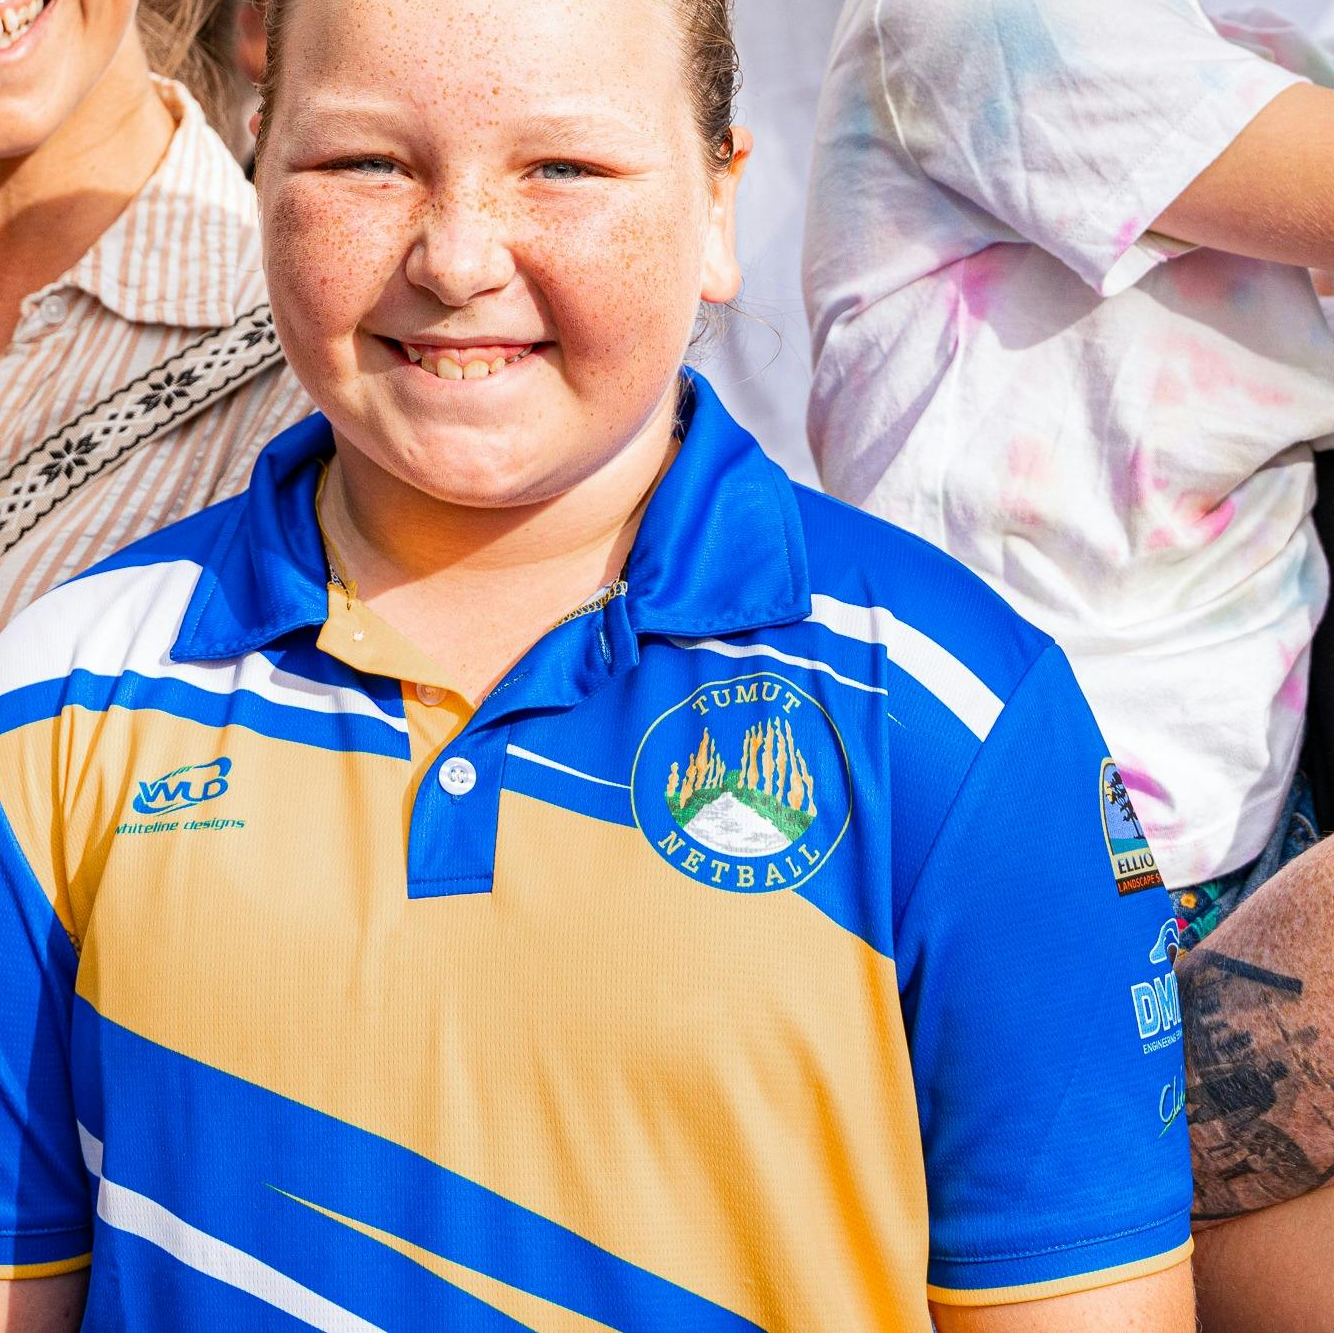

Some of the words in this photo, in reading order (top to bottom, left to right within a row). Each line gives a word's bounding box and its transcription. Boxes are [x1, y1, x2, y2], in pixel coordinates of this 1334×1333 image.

[691, 681, 802, 716] TUMUT
[183, 817, 245, 831] designs
[657, 830, 820, 888] NETBALL
[1117, 852, 1155, 875] ELLIO
